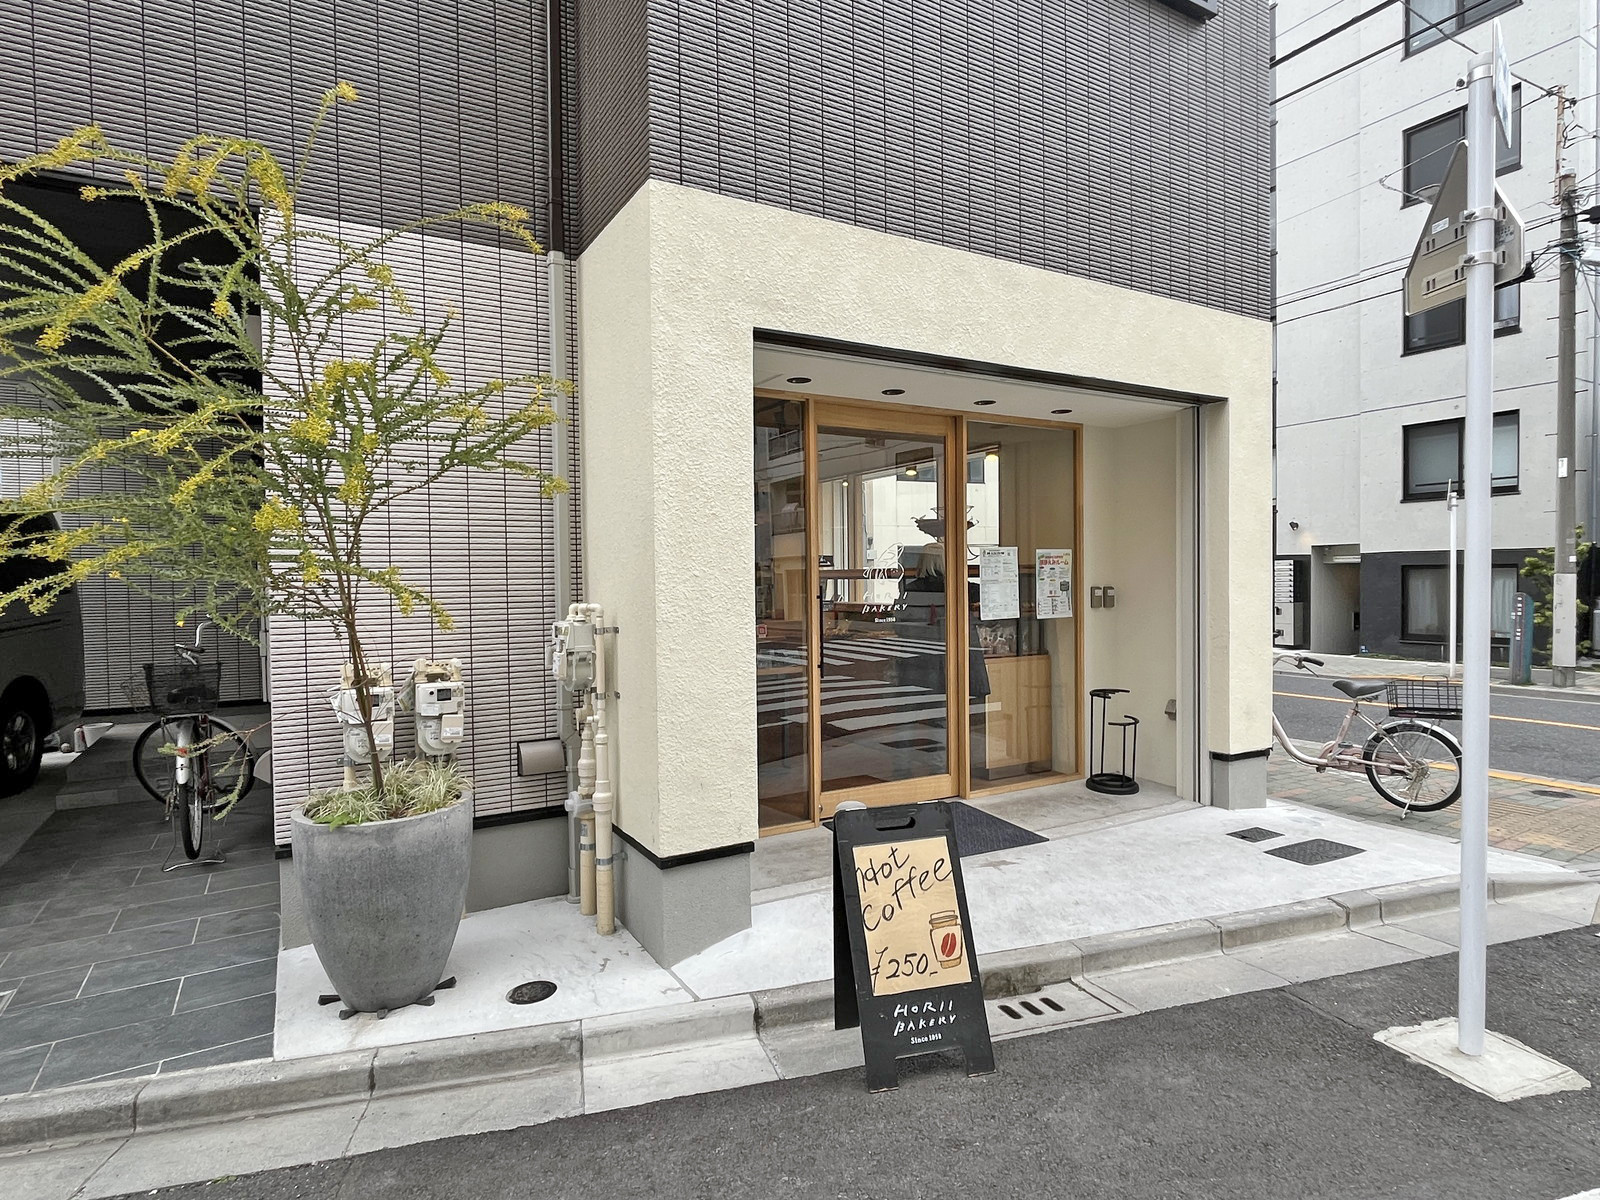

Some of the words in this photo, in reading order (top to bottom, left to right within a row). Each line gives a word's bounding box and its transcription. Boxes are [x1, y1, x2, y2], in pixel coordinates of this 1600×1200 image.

[861, 603, 908, 614] BAKERY
[893, 1000, 953, 1018] HORII
[893, 1014, 957, 1037] BAKERY
[910, 1036, 929, 1044] Since
